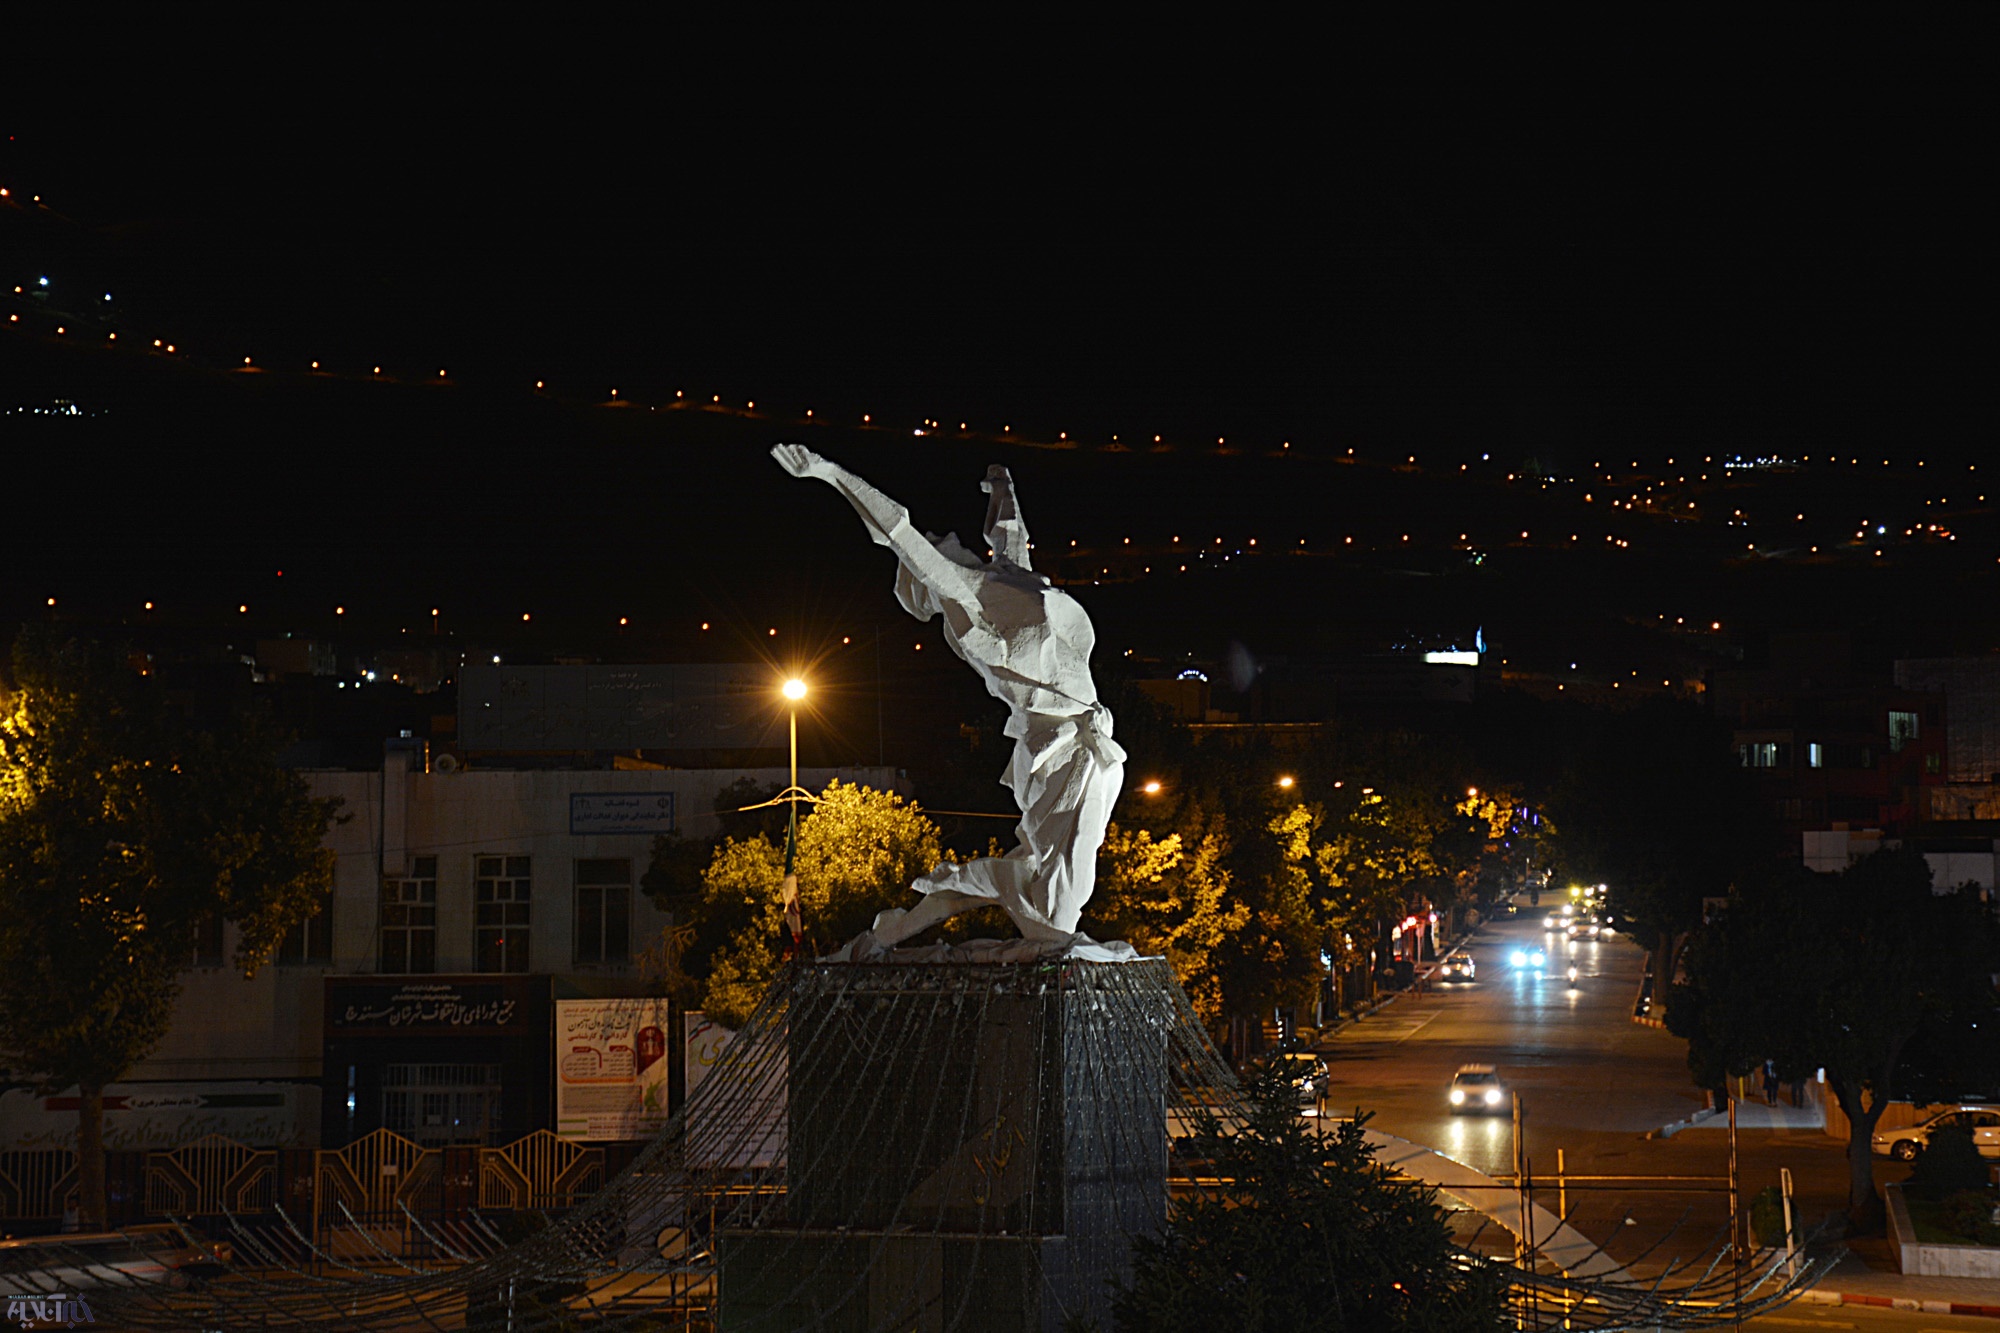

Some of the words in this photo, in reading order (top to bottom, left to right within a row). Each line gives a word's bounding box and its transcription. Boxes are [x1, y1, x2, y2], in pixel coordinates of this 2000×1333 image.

[344, 1003, 396, 1022] سنندج
[389, 1001, 423, 1026] شهرستان
[495, 1000, 516, 1025] مجتمع
